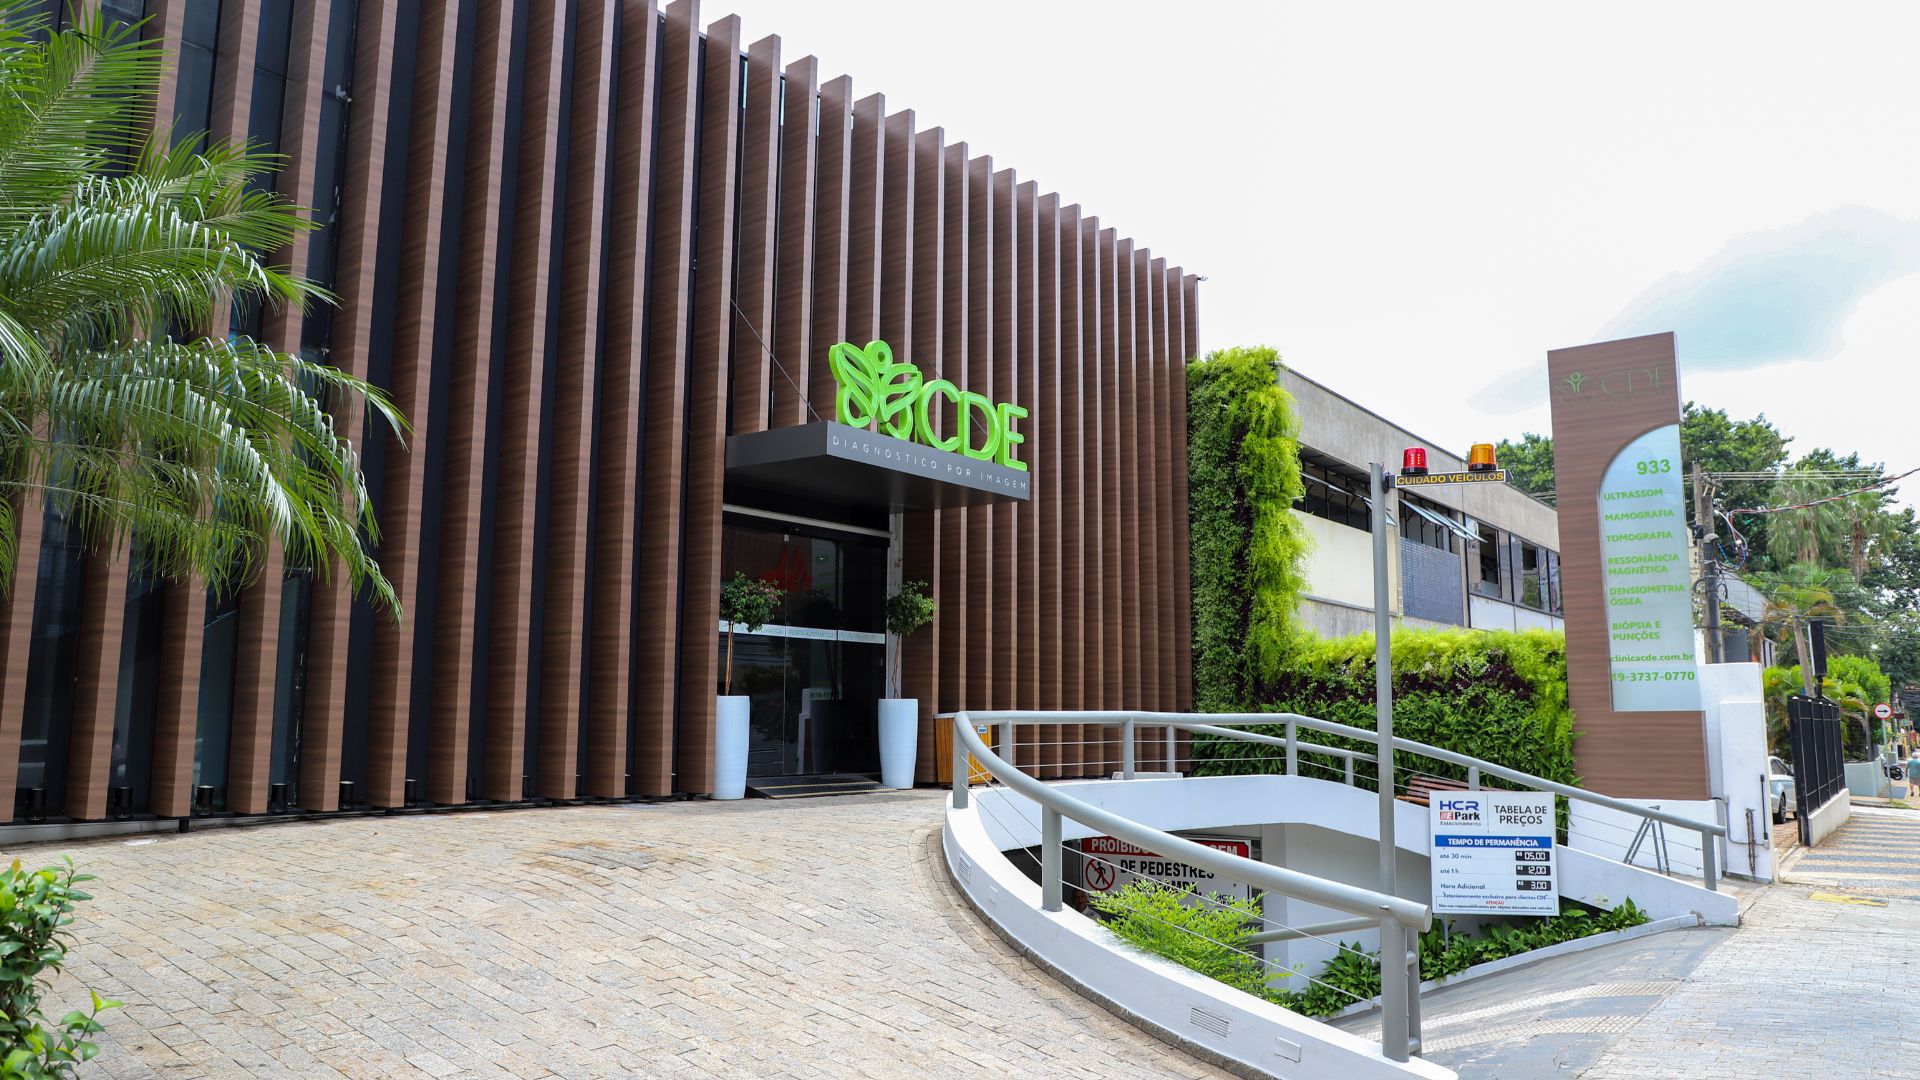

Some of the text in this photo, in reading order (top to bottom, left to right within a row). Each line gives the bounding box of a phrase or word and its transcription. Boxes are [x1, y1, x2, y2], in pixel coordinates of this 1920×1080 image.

[914, 379, 1028, 472] CDE
[1636, 459, 1671, 476] 933
[947, 463, 972, 478] POR
[980, 473, 1027, 491] IMAGEM
[1397, 474, 1446, 486] CUIDADO
[1604, 489, 1663, 500] ULTRASSOM
[1605, 510, 1674, 521] MAMOGRAFIA
[1606, 531, 1673, 544] TOMOGRAFIA
[1608, 553, 1679, 565] RESSONÂNCIA
[1608, 563, 1669, 576] MAGNÉTICA
[1610, 584, 1685, 595] DENSIOMETRIA
[1610, 596, 1642, 606] ÓSSEA
[1612, 621, 1662, 631] BIÓPSIA E
[1612, 631, 1661, 642] PUNÇÕES
[1611, 653, 1694, 663] clinicacde.com.br
[1611, 671, 1696, 683] 19-3737-0770
[1439, 800, 1480, 811] HCR
[1494, 806, 1547, 815] TABELA DE
[1455, 812, 1481, 821] Park
[1499, 815, 1543, 827] PREÇOS
[1091, 838, 1149, 854] PROIBID
[1447, 838, 1473, 846] TEMPO
[1485, 837, 1539, 847] PERMANÊNCIA
[1524, 852, 1546, 861] 05,00
[1120, 859, 1137, 874] DE
[1528, 866, 1547, 876] 12,00
[1531, 881, 1547, 891] 3,00
